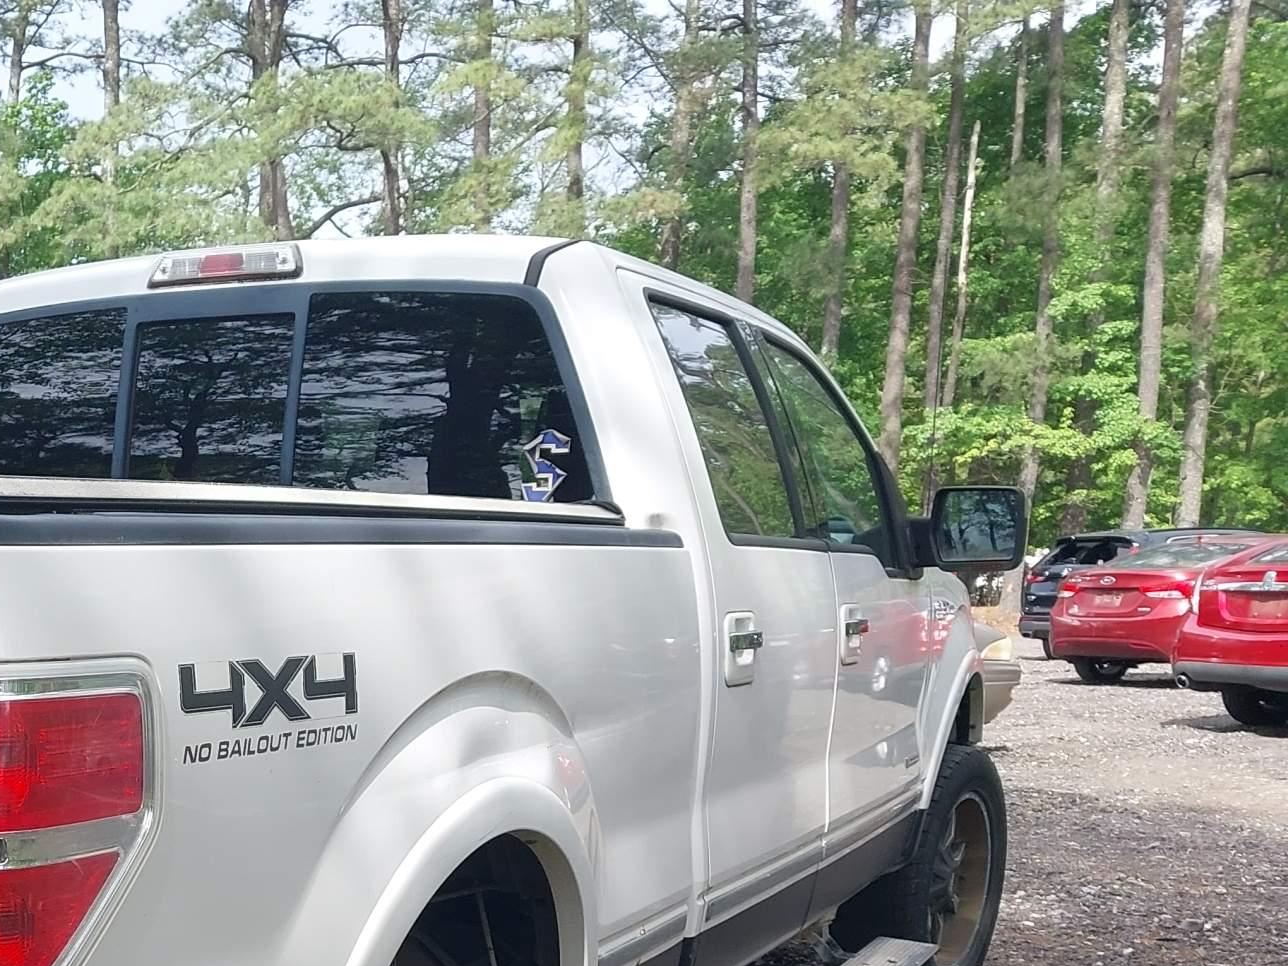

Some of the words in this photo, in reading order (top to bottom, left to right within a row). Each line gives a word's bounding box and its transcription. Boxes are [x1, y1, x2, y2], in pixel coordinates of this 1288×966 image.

[183, 742, 212, 764] NO
[217, 732, 293, 760] BAILOUT
[296, 724, 358, 749] EDITION
